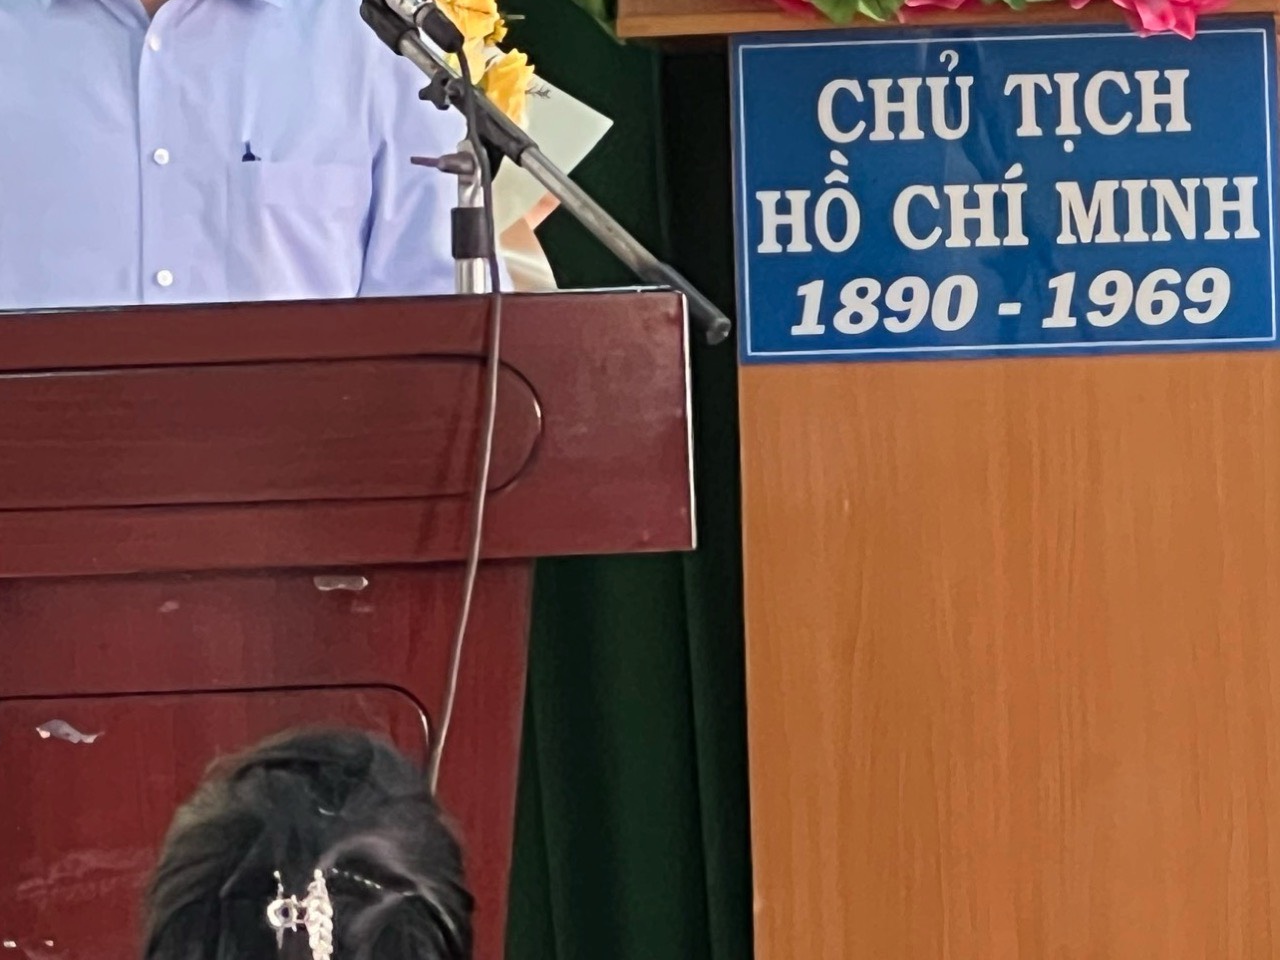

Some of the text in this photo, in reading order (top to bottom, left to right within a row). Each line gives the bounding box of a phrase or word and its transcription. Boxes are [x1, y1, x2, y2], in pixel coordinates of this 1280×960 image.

[817, 49, 1192, 153] CHỦ TỊCH
[755, 149, 1261, 254] HỒ CHÍ MINH
[790, 274, 979, 336] 1890
[1041, 266, 1231, 329] 1969
